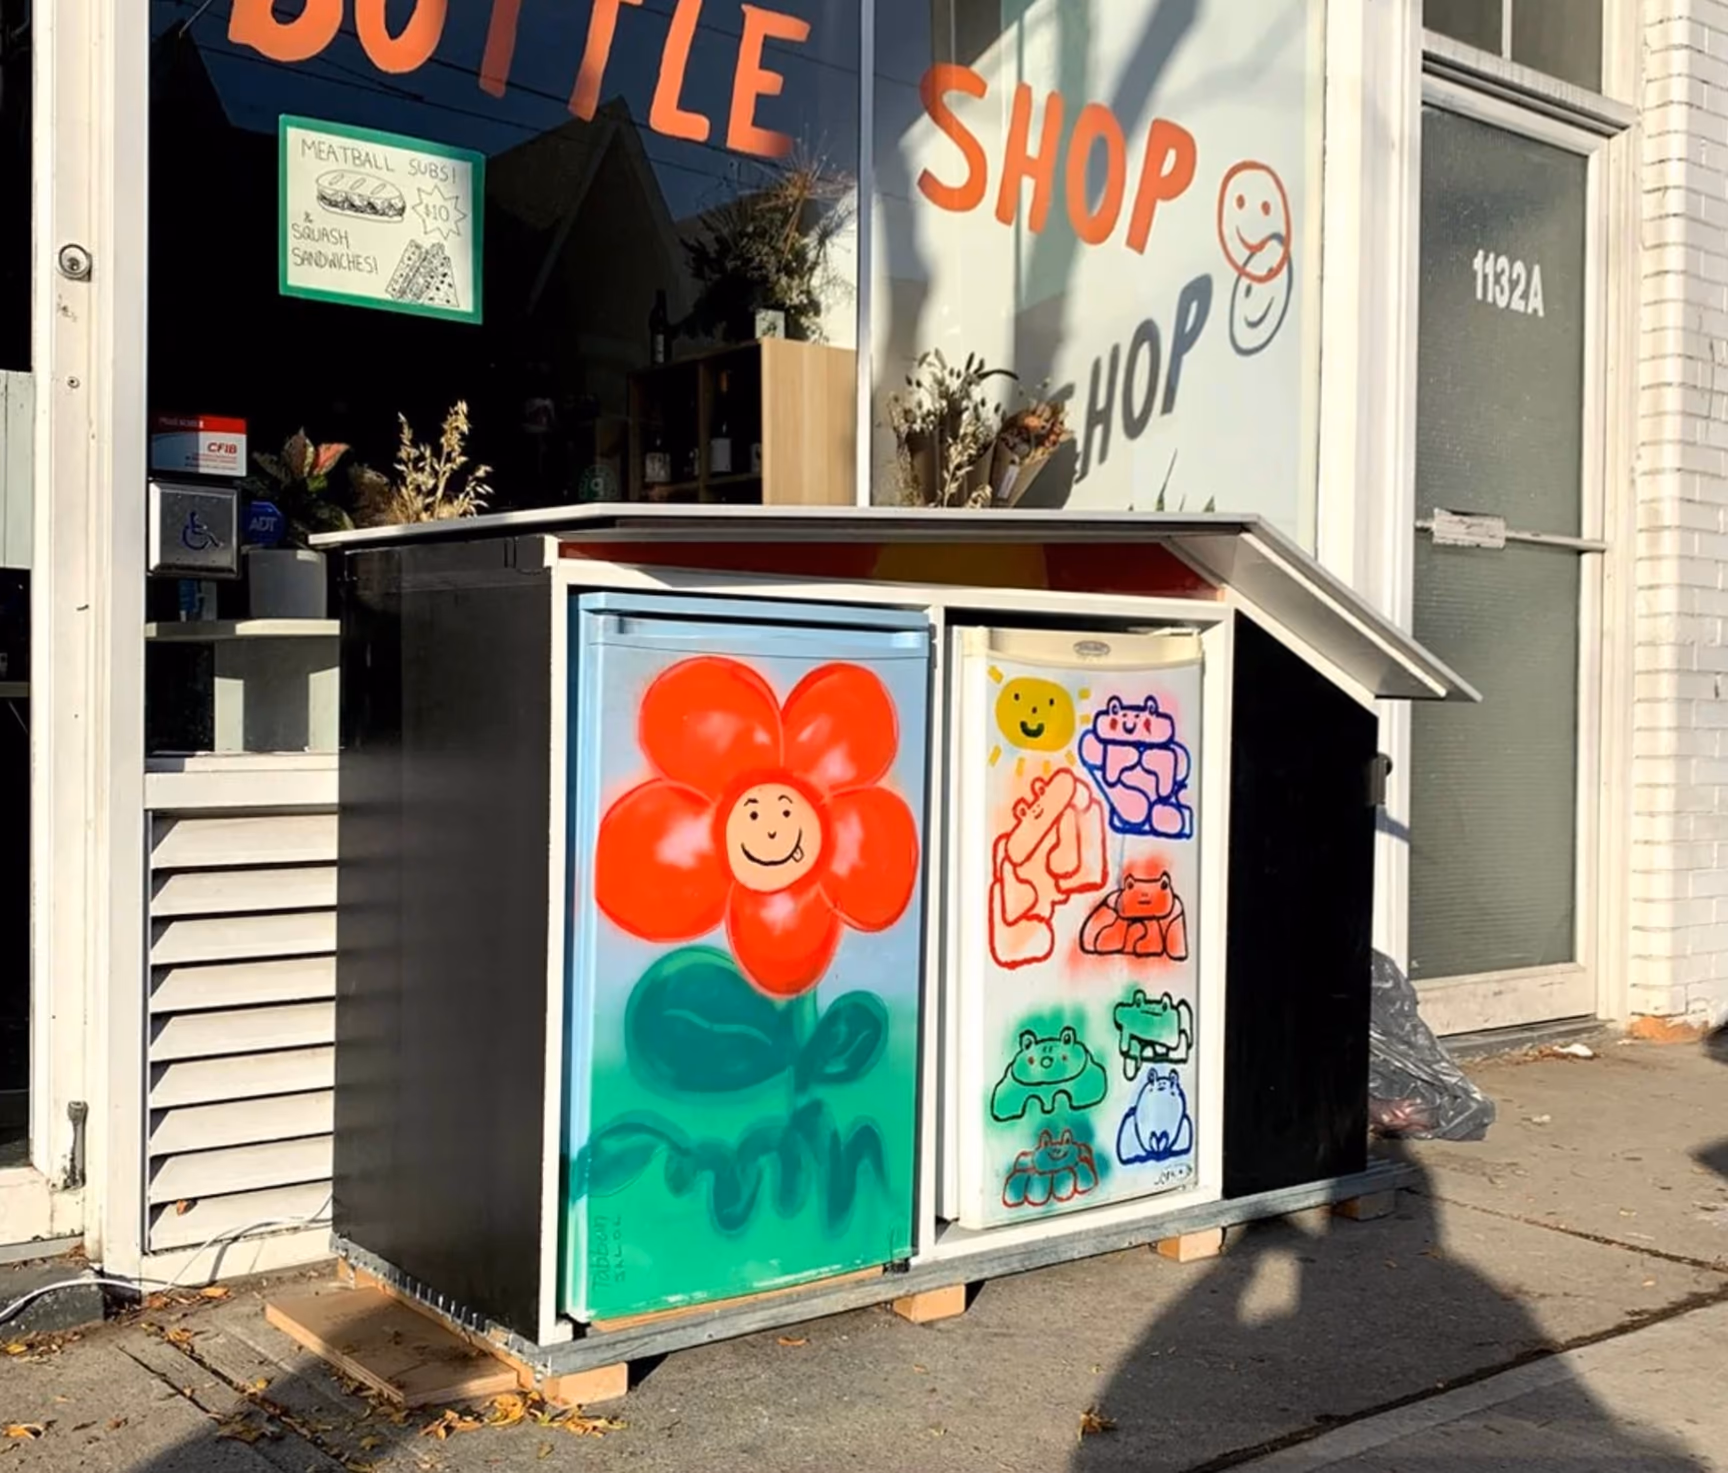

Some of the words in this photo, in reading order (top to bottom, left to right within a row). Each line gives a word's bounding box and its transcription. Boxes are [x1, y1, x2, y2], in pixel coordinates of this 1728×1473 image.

[300, 138, 396, 173] MEATBALL
[407, 158, 457, 185] SUBS!
[917, 63, 1198, 255] SHOP
[423, 203, 451, 222] $10
[291, 223, 350, 249] SQUASH
[291, 247, 379, 275] SANDWICHES!
[1473, 249, 1545, 318] 1132A
[1045, 273, 1214, 485] HOP
[207, 441, 238, 455] CFIB
[248, 516, 278, 533] ADT
